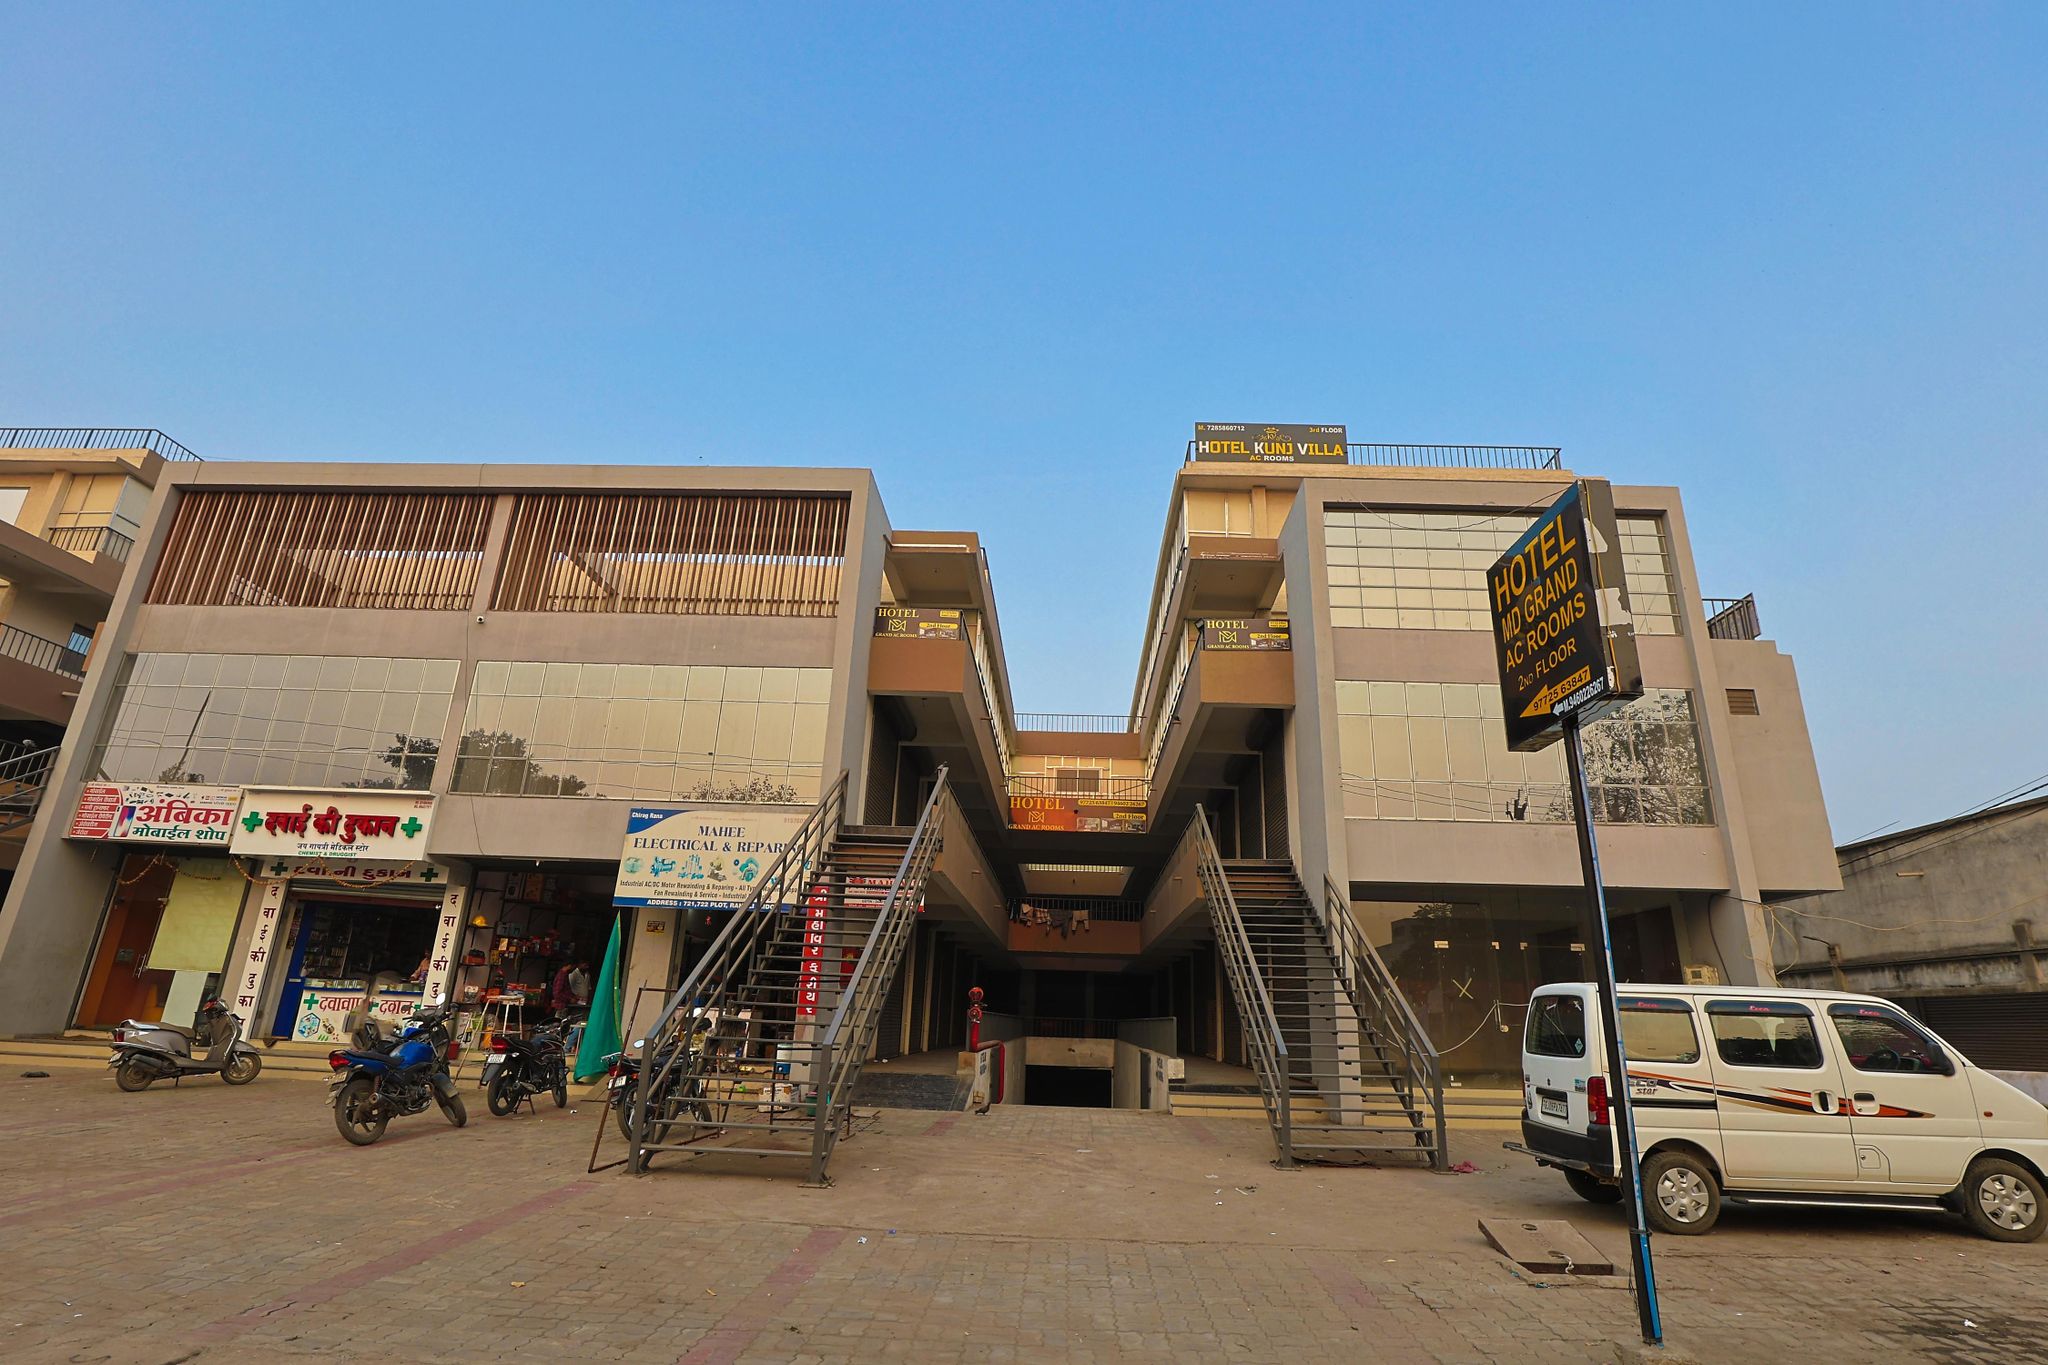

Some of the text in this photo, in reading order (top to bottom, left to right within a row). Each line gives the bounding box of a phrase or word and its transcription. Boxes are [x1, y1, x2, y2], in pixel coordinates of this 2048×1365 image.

[1198, 440, 1344, 456] HOTEL KUNJ VILLA
[1494, 514, 1577, 613] HOTEL
[1501, 557, 1578, 643] MD GRAND
[878, 608, 919, 618] HOTEL
[1206, 620, 1249, 629] HOTEL
[1505, 592, 1586, 673] AC ROOMS
[1518, 637, 1577, 691] 2ND FLOOR
[1533, 669, 1588, 711] 97725 63847
[1009, 796, 1065, 810] HOTEL
[135, 798, 234, 826] अंबिका
[631, 811, 649, 820] Chirag
[264, 803, 401, 844] दवाई की दुकान
[132, 824, 228, 841] मोबाईल शोप
[697, 825, 746, 838] MAHEE
[633, 837, 718, 852] ELECTRICAL
[722, 842, 732, 852] &
[661, 881, 676, 889] Motor
[699, 891, 717, 899] Service
[722, 892, 747, 900] Industrial
[1635, 1087, 1658, 1096] star
